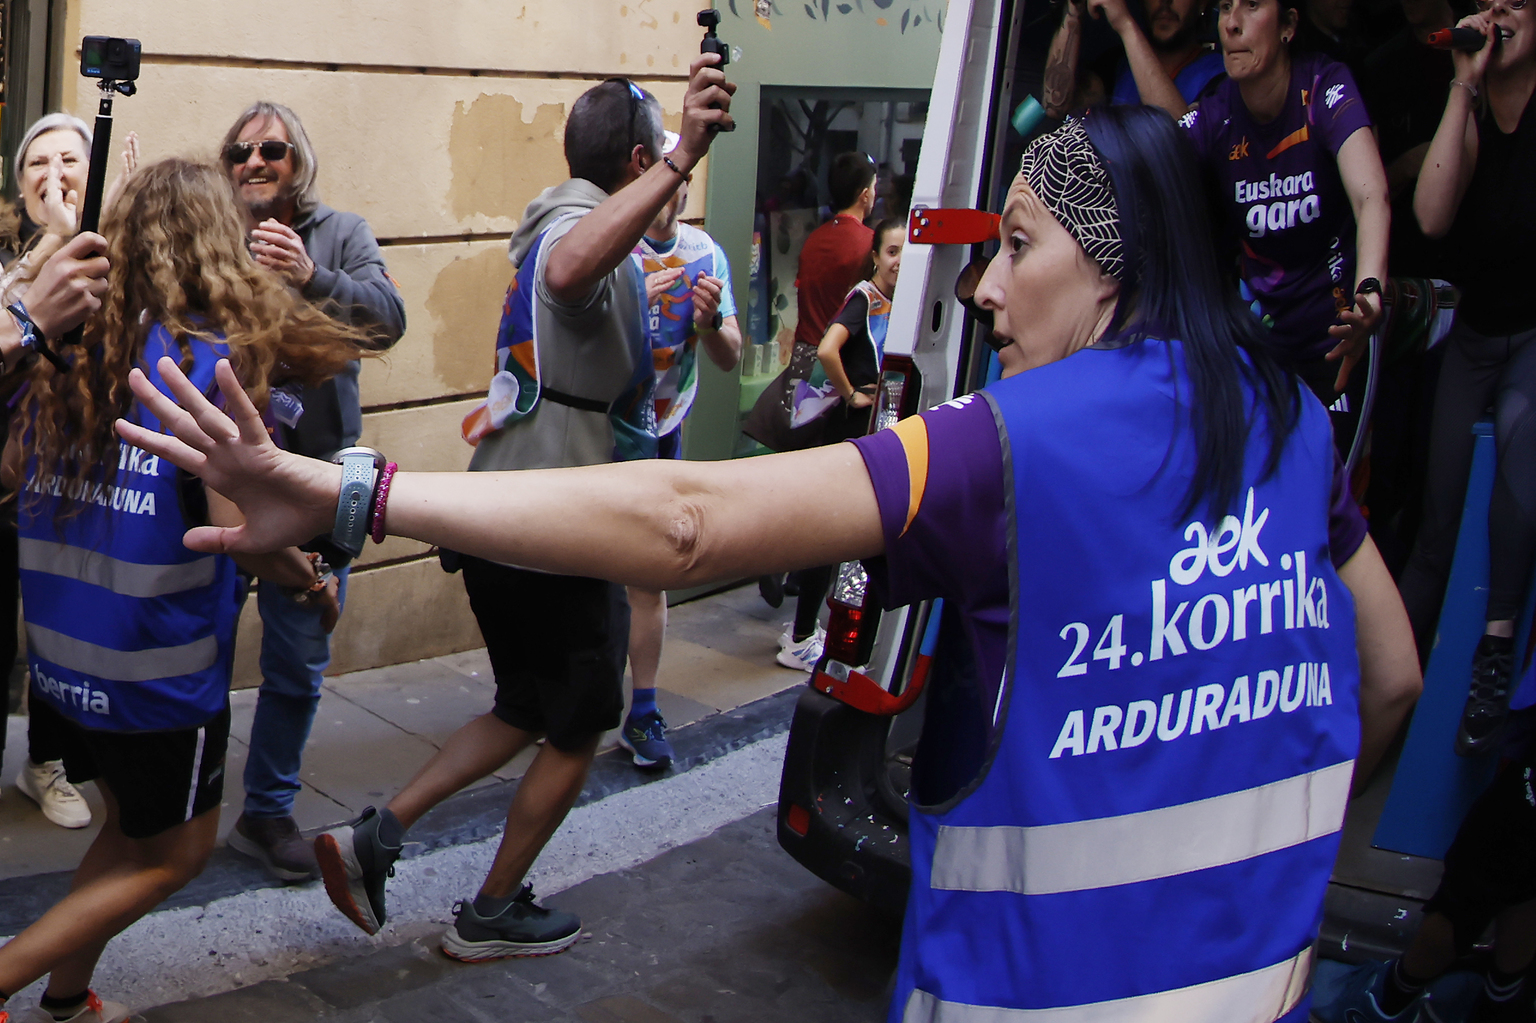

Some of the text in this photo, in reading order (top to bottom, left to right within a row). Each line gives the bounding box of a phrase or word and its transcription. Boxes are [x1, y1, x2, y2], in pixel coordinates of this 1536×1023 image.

[1234, 170, 1315, 204] Euskara
[1245, 194, 1321, 238] gara
[1170, 487, 1271, 585] aek
[35, 663, 110, 715] berria
[1049, 662, 1334, 759] ARDURADUNA
